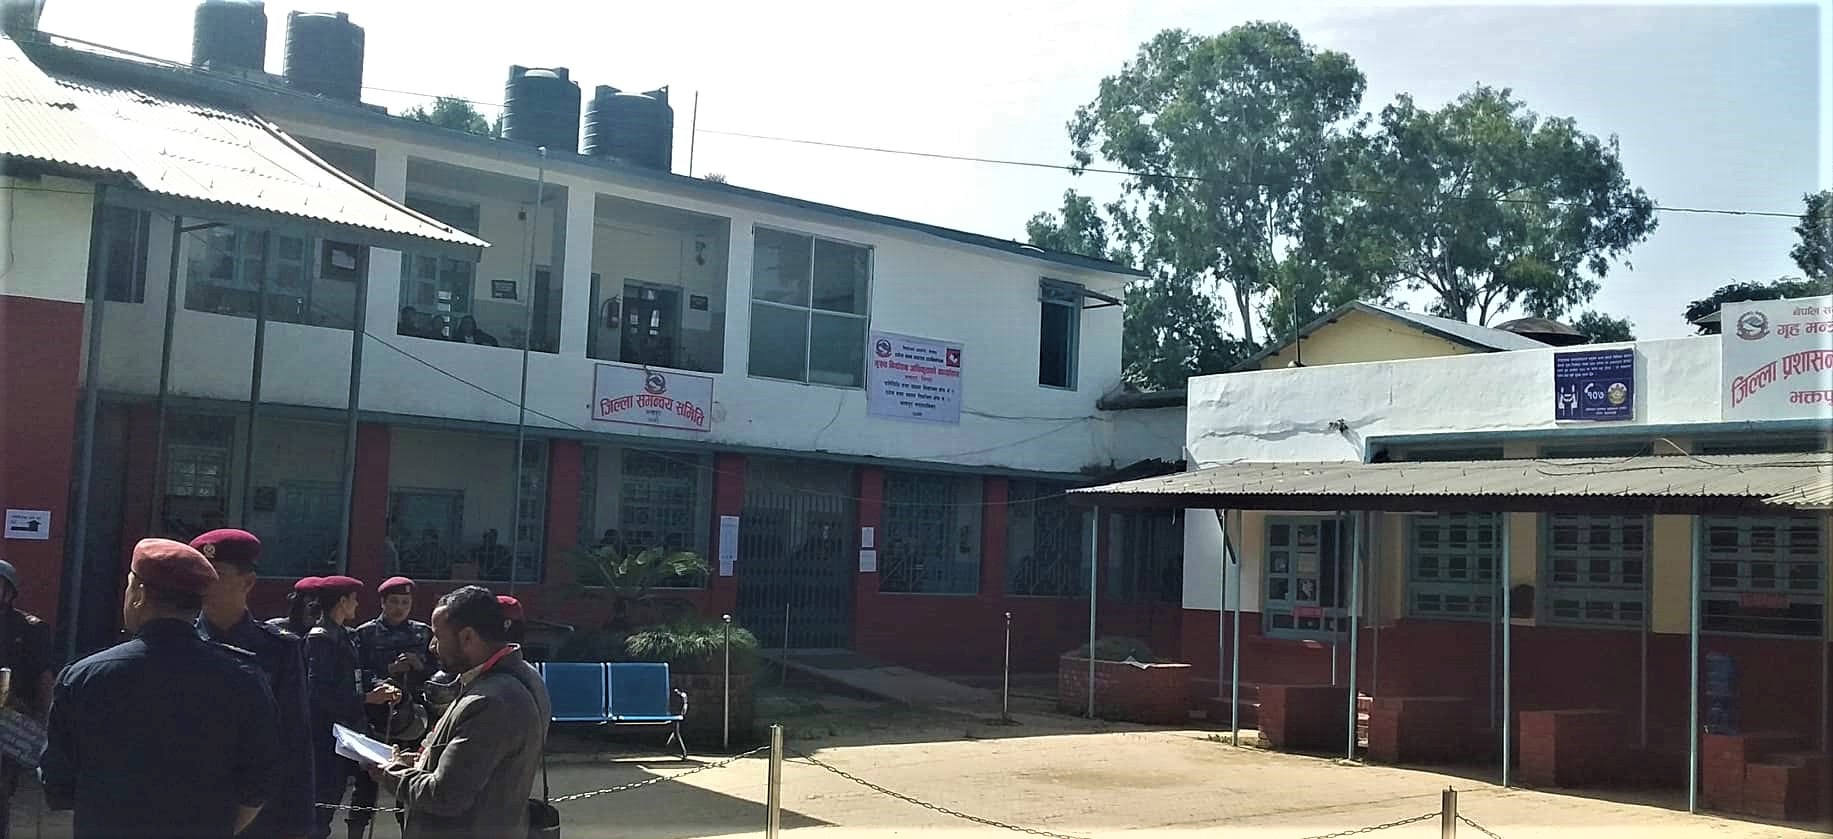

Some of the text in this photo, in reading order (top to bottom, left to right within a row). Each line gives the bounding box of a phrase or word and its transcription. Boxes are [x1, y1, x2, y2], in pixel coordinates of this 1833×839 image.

[1777, 323, 1801, 339] गृह
[1731, 361, 1778, 408] जिल्ला
[600, 394, 705, 426] जिल्ला समन्वय समिति
